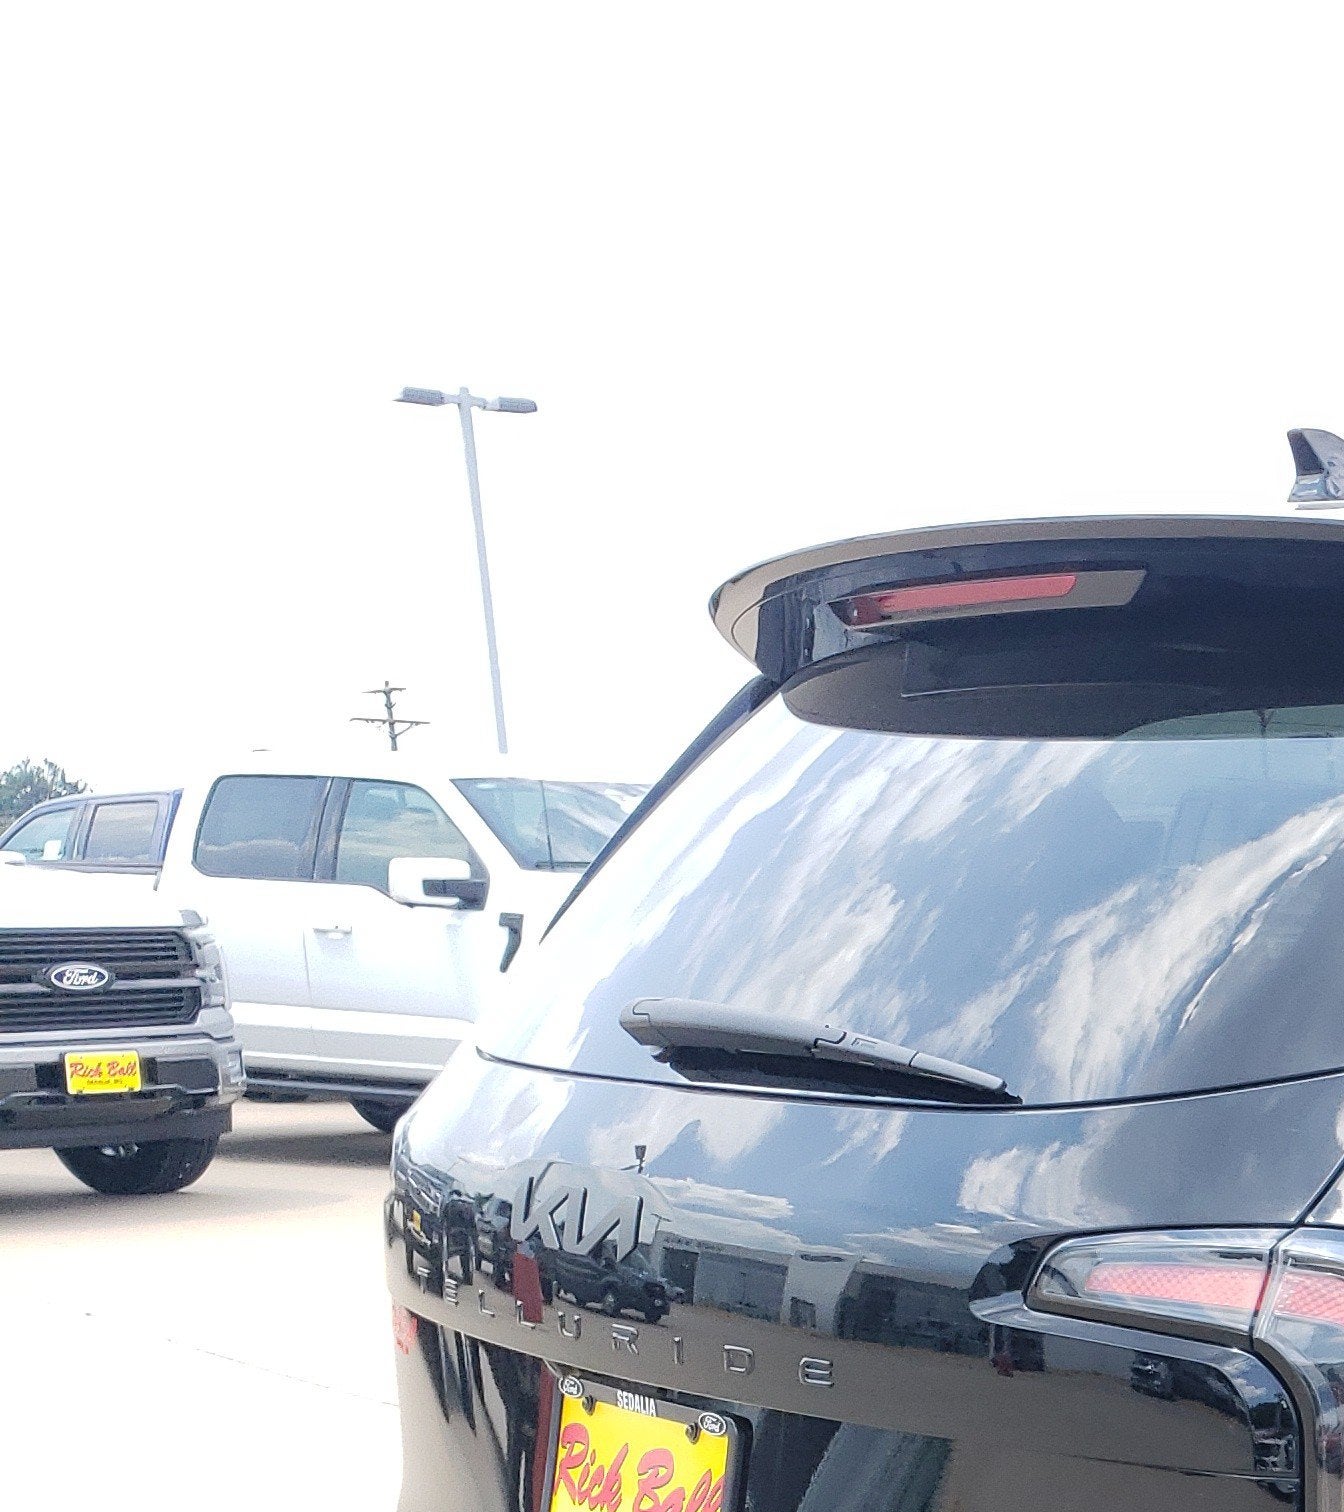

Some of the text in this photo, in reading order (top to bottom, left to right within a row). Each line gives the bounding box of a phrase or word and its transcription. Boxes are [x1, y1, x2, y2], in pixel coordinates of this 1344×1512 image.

[62, 968, 99, 986] Ford
[69, 1060, 137, 1078] Rick Ball
[416, 1265, 835, 1387] TELLURIDE
[616, 1390, 657, 1417] SEDALIA
